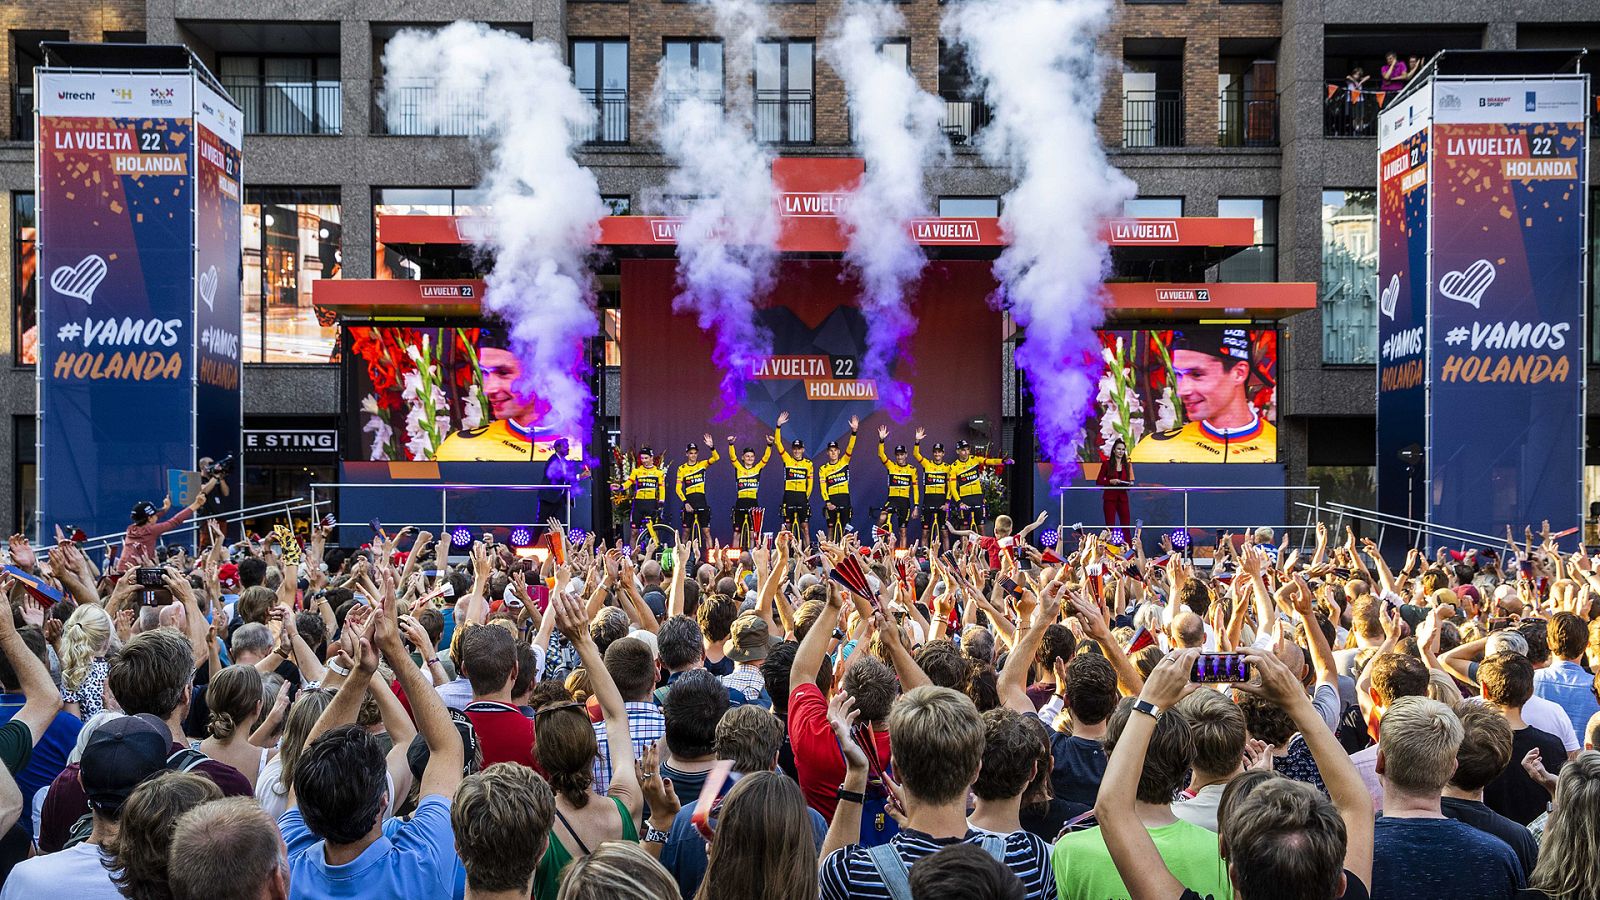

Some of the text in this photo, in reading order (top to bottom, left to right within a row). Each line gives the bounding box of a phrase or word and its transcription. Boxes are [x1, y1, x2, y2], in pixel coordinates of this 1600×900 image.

[55, 131, 161, 151] LA VUELTA 22
[1447, 138, 1552, 156] LA VUELTA 22
[116, 156, 182, 172] HOLANDA
[226, 156, 233, 175] 22
[1411, 147, 1419, 167] 22
[1506, 161, 1572, 177] HOLANDA
[786, 197, 801, 212] LA
[659, 224, 671, 237] LA
[918, 224, 973, 237] LA VUELTA
[1117, 225, 1172, 238] LA VUELTA
[424, 287, 471, 296] LA VUELTA 22
[1160, 291, 1207, 300] LA VUELTA 22
[57, 317, 182, 347] #VAMOS
[1445, 320, 1570, 351] #VAMOS
[201, 325, 238, 360] #VAMOS
[1382, 326, 1424, 362] #VAMOS
[53, 351, 182, 381] HOLANDA
[200, 356, 238, 390] HOLANDA
[752, 359, 853, 376] LA VUELTA 22
[1441, 354, 1569, 384] HOLANDA
[1381, 359, 1423, 392] HOLANDA
[810, 383, 873, 396] HOLANDA
[265, 434, 332, 447] STING
[502, 440, 527, 454] JUMBO
[1196, 441, 1220, 455] JUMBO
